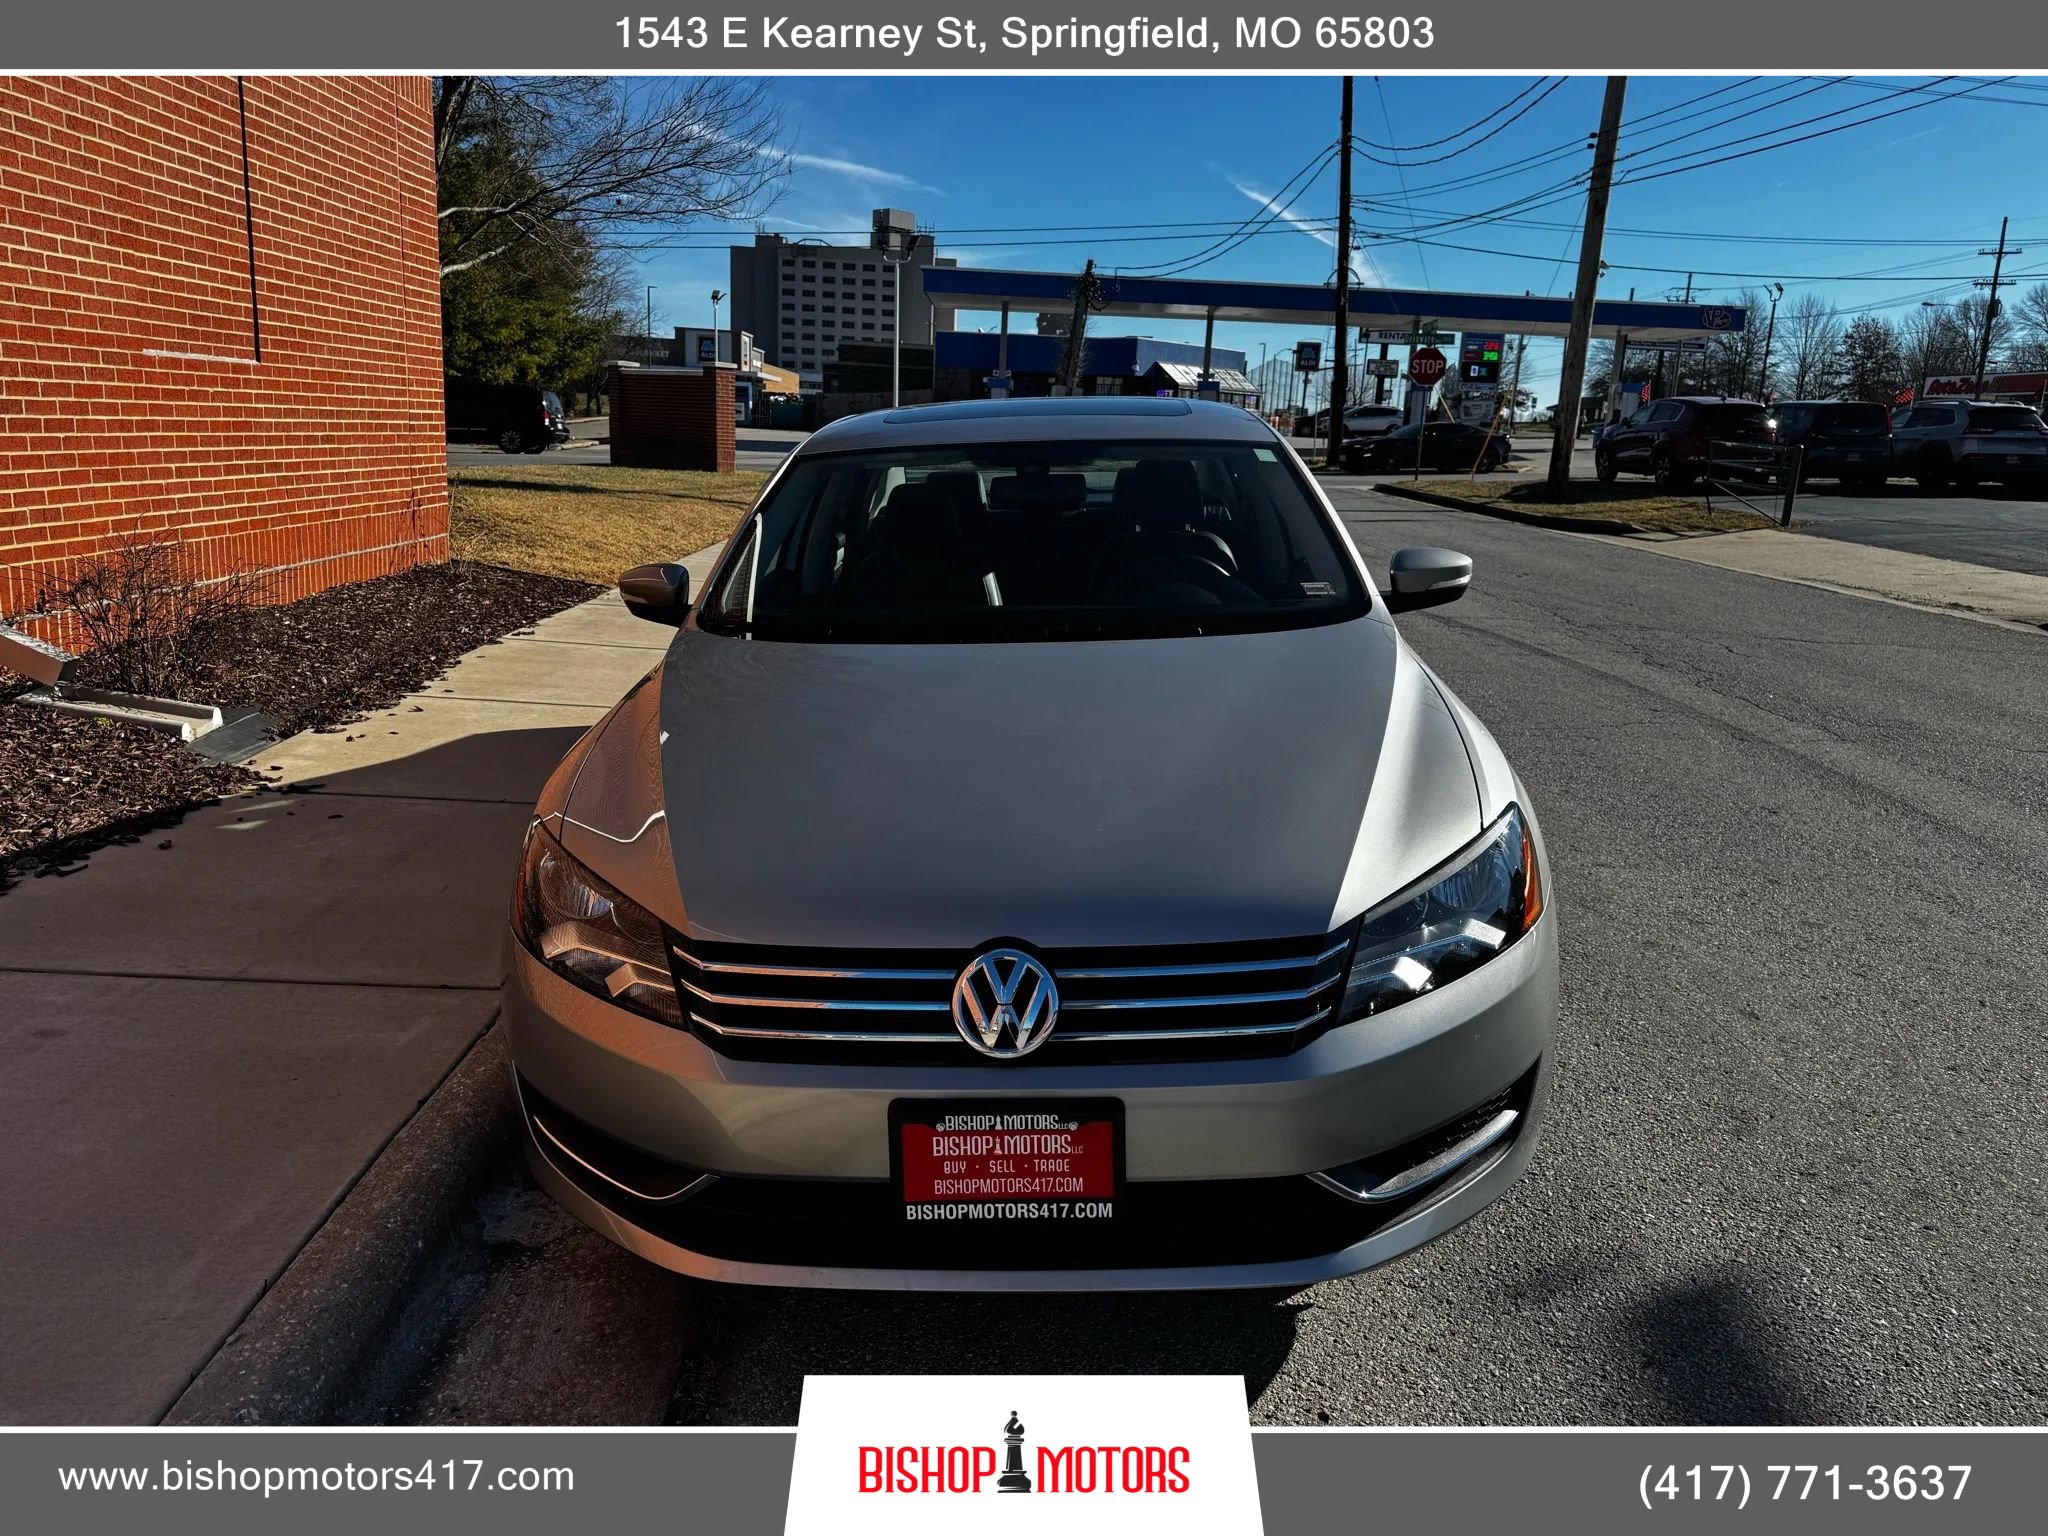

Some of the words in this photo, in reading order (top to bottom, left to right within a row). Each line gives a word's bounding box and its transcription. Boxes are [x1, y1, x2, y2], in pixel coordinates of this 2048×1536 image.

[1411, 359, 1444, 374] STOP
[945, 1115, 994, 1131] BISHOP
[1003, 1114, 1059, 1130] MOTORS
[932, 1135, 993, 1157] BISHOP
[1004, 1134, 1072, 1155] MOTORS
[1071, 1145, 1084, 1154] LLC
[943, 1160, 967, 1174] BUY
[989, 1160, 1016, 1173] SELL
[1033, 1158, 1070, 1172] TRADE
[934, 1177, 1083, 1195] BISHOPMOTORS417.COM
[906, 1202, 1113, 1220] BISHOPMOTORS417.COM
